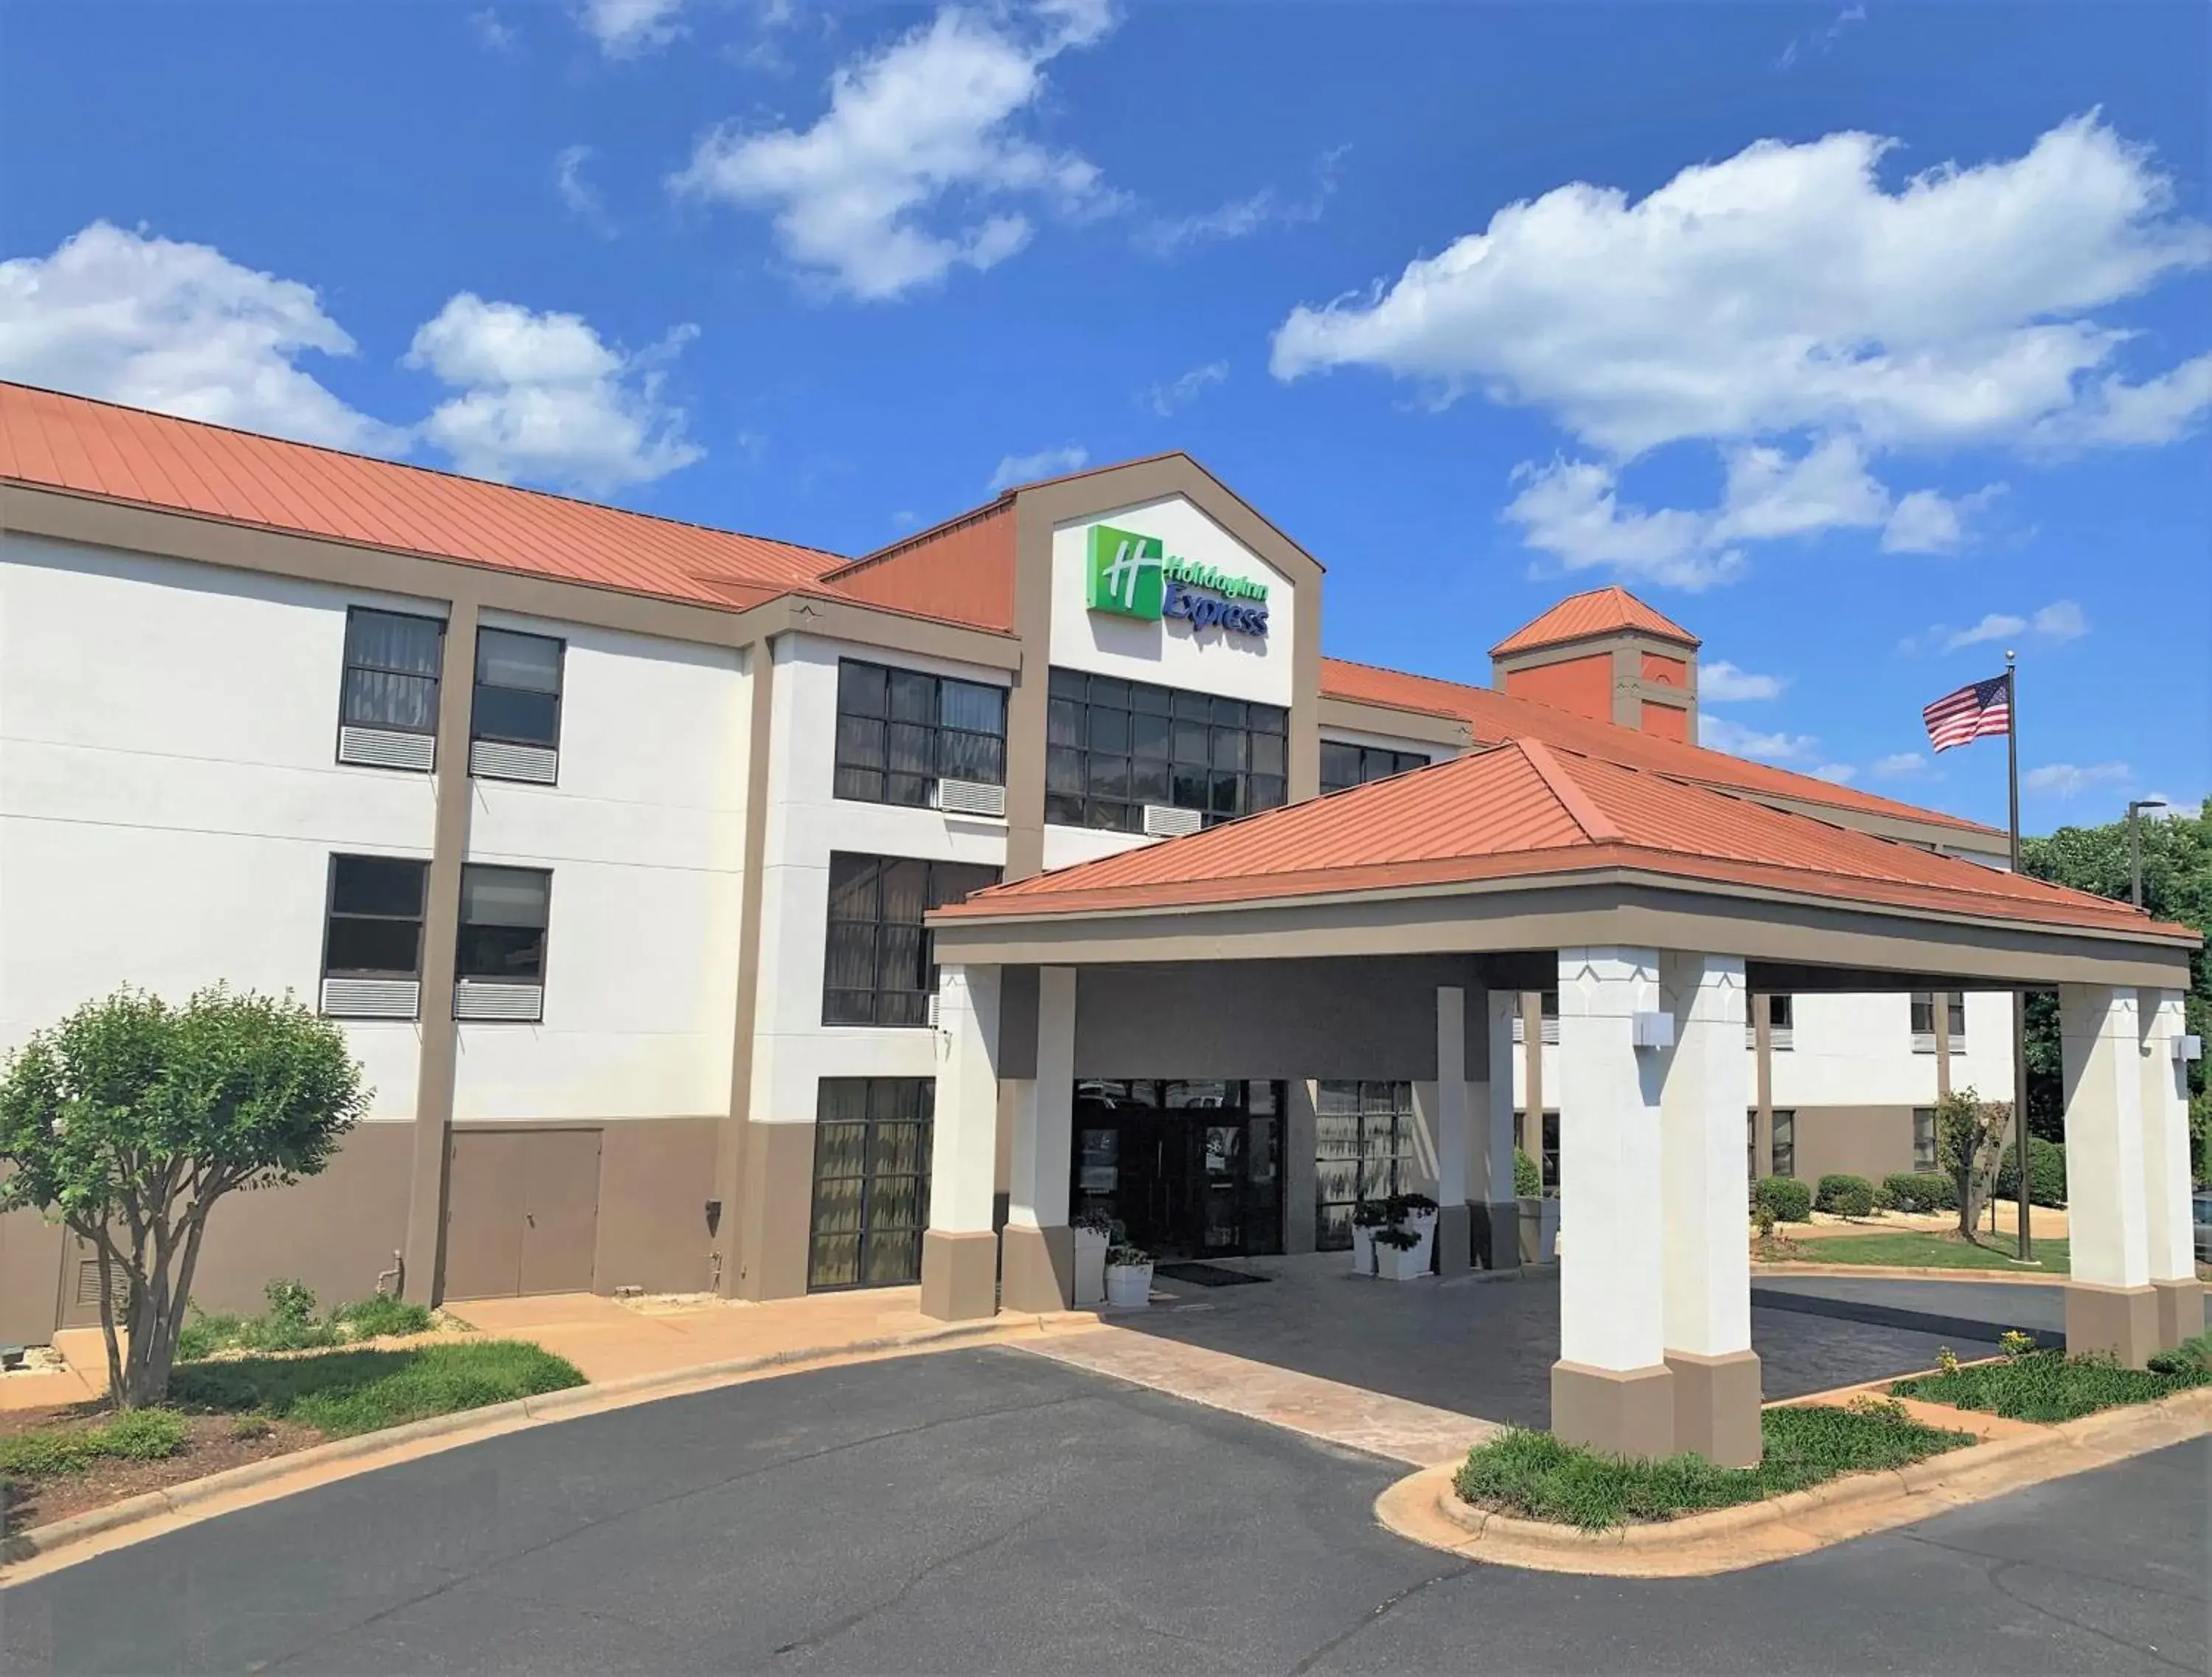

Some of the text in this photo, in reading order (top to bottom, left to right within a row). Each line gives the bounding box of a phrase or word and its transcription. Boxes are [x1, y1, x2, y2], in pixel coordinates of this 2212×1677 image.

[1102, 540, 1161, 608] H
[1163, 555, 1268, 602] Holiday Inn
[1163, 583, 1269, 636] Express
